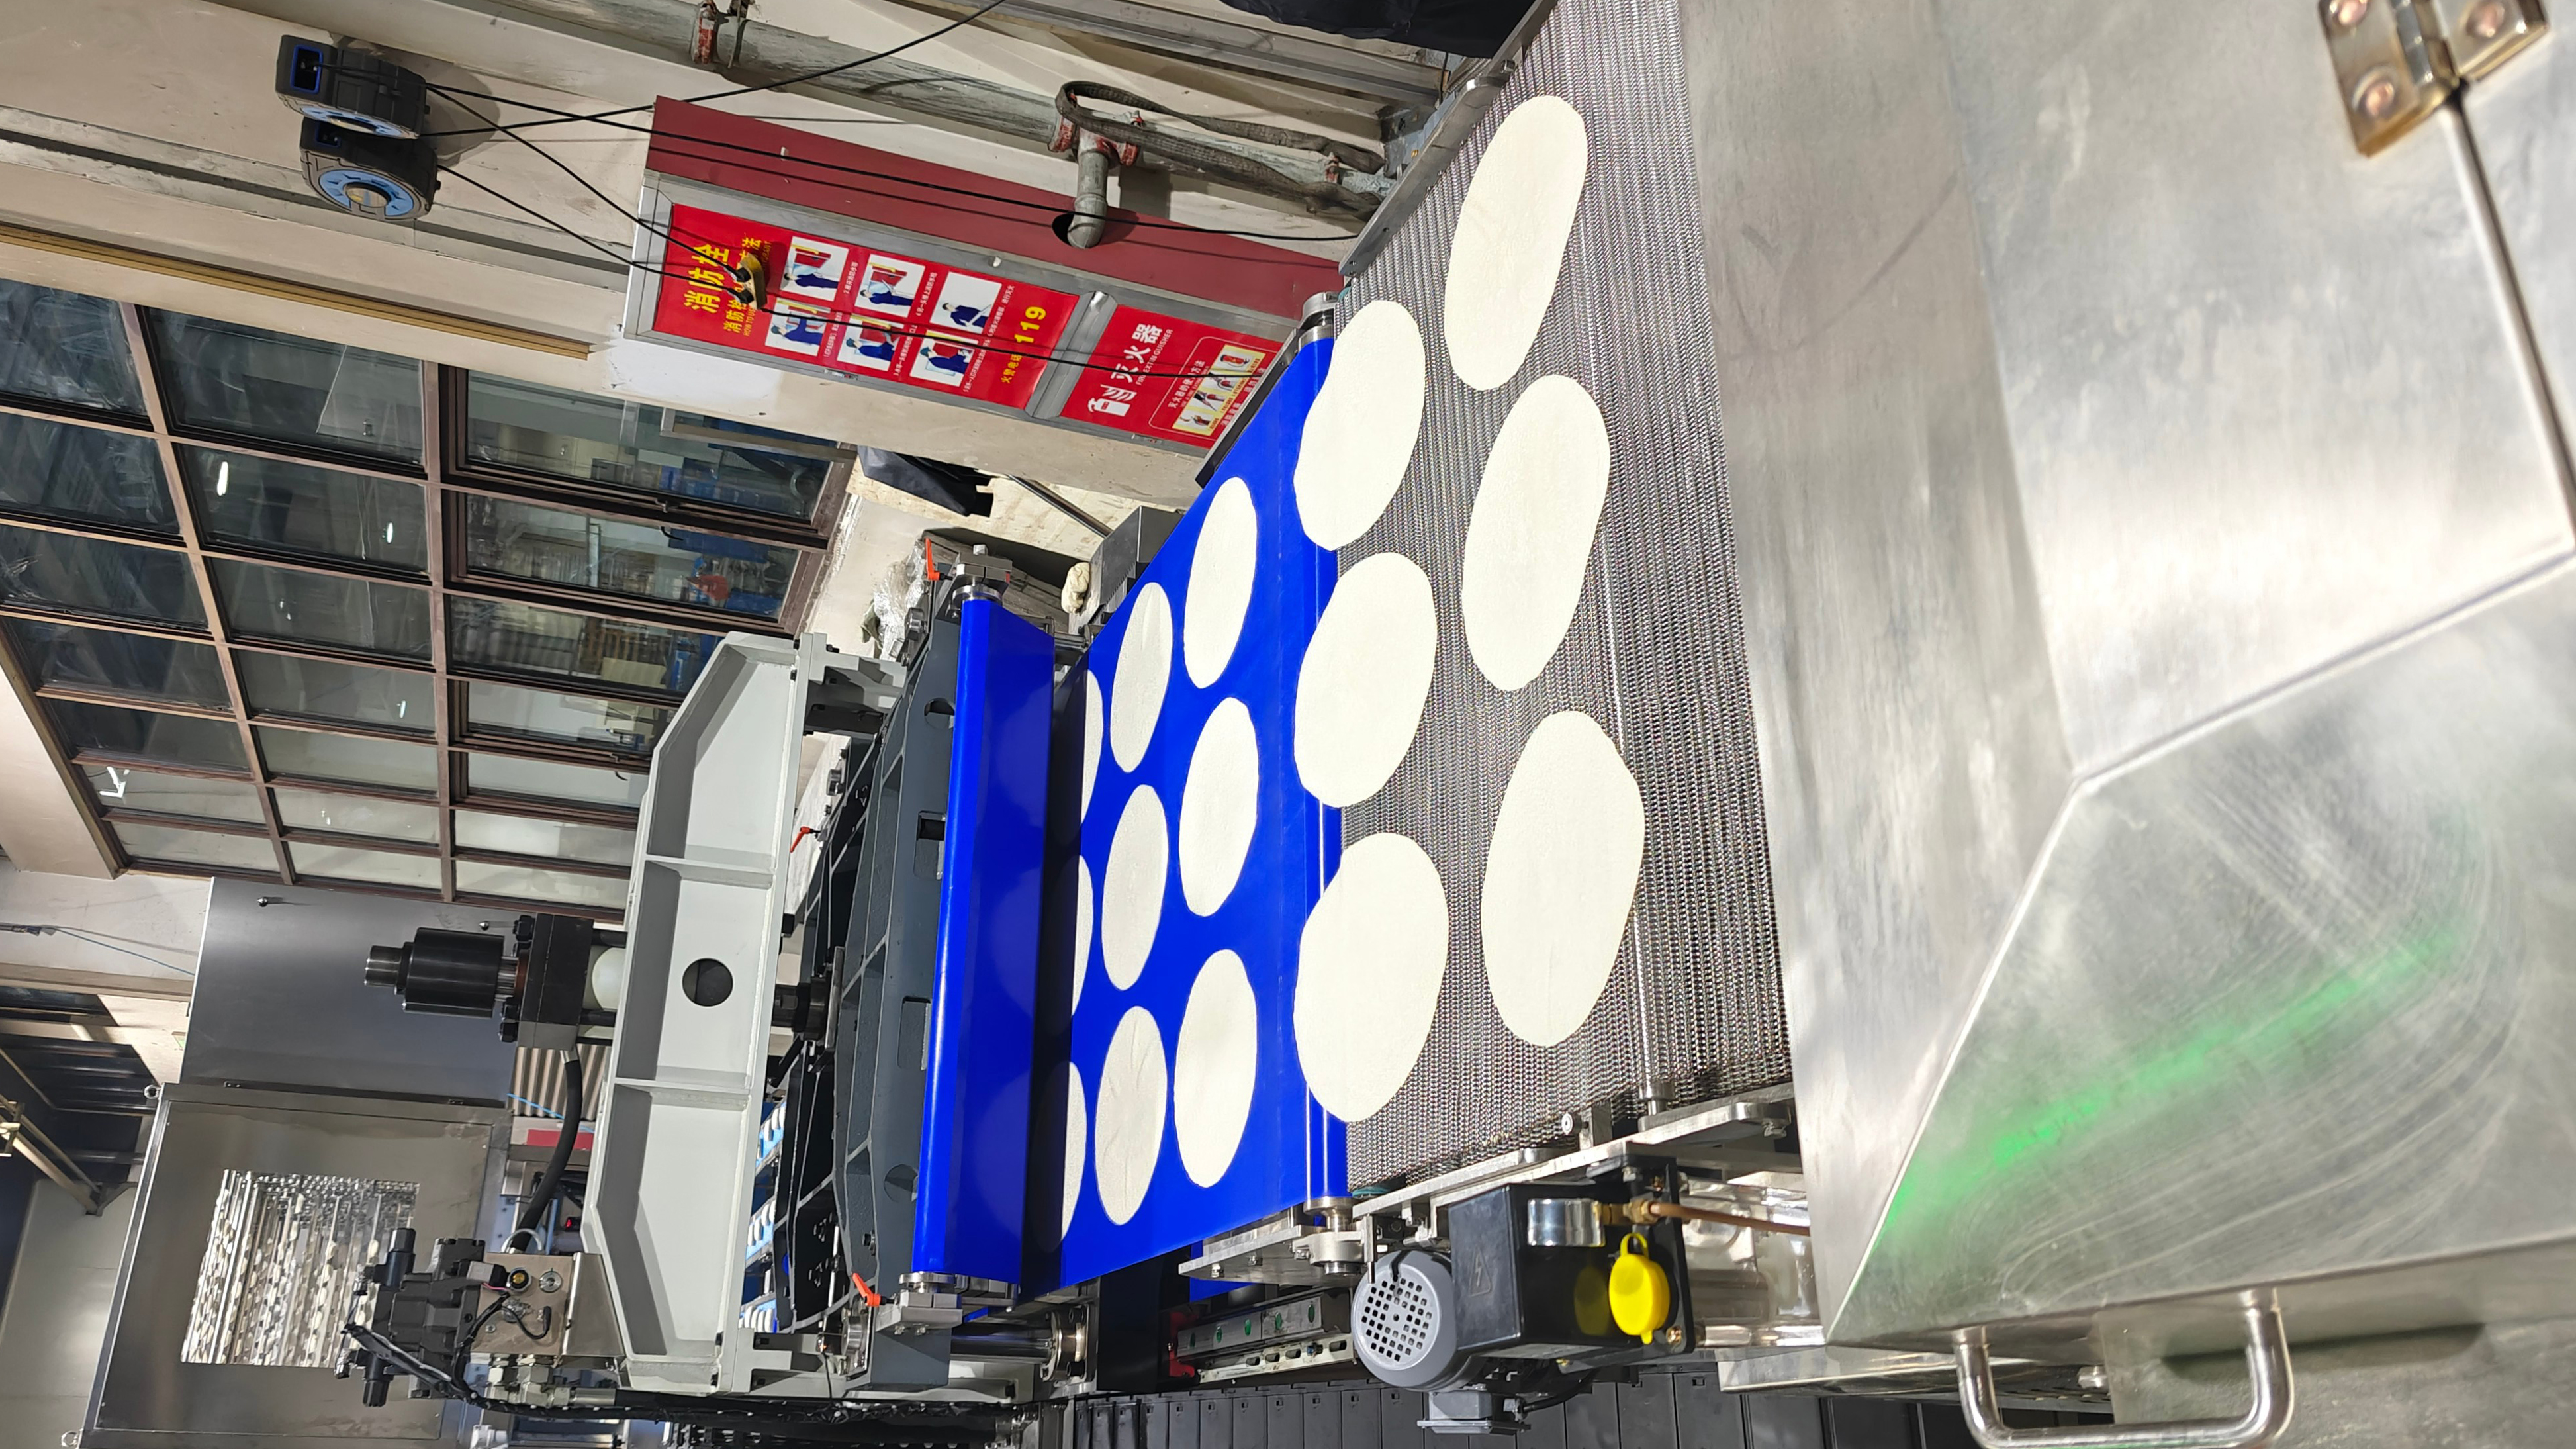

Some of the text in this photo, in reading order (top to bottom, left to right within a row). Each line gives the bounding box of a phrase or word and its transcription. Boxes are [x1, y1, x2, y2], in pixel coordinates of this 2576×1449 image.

[684, 244, 729, 314] 消防栓
[743, 324, 753, 336] HOW
[745, 316, 754, 325] TO
[1001, 306, 1046, 383] 火警电话 119
[1110, 324, 1163, 383] 灭火器
[1135, 375, 1146, 385] FIR
